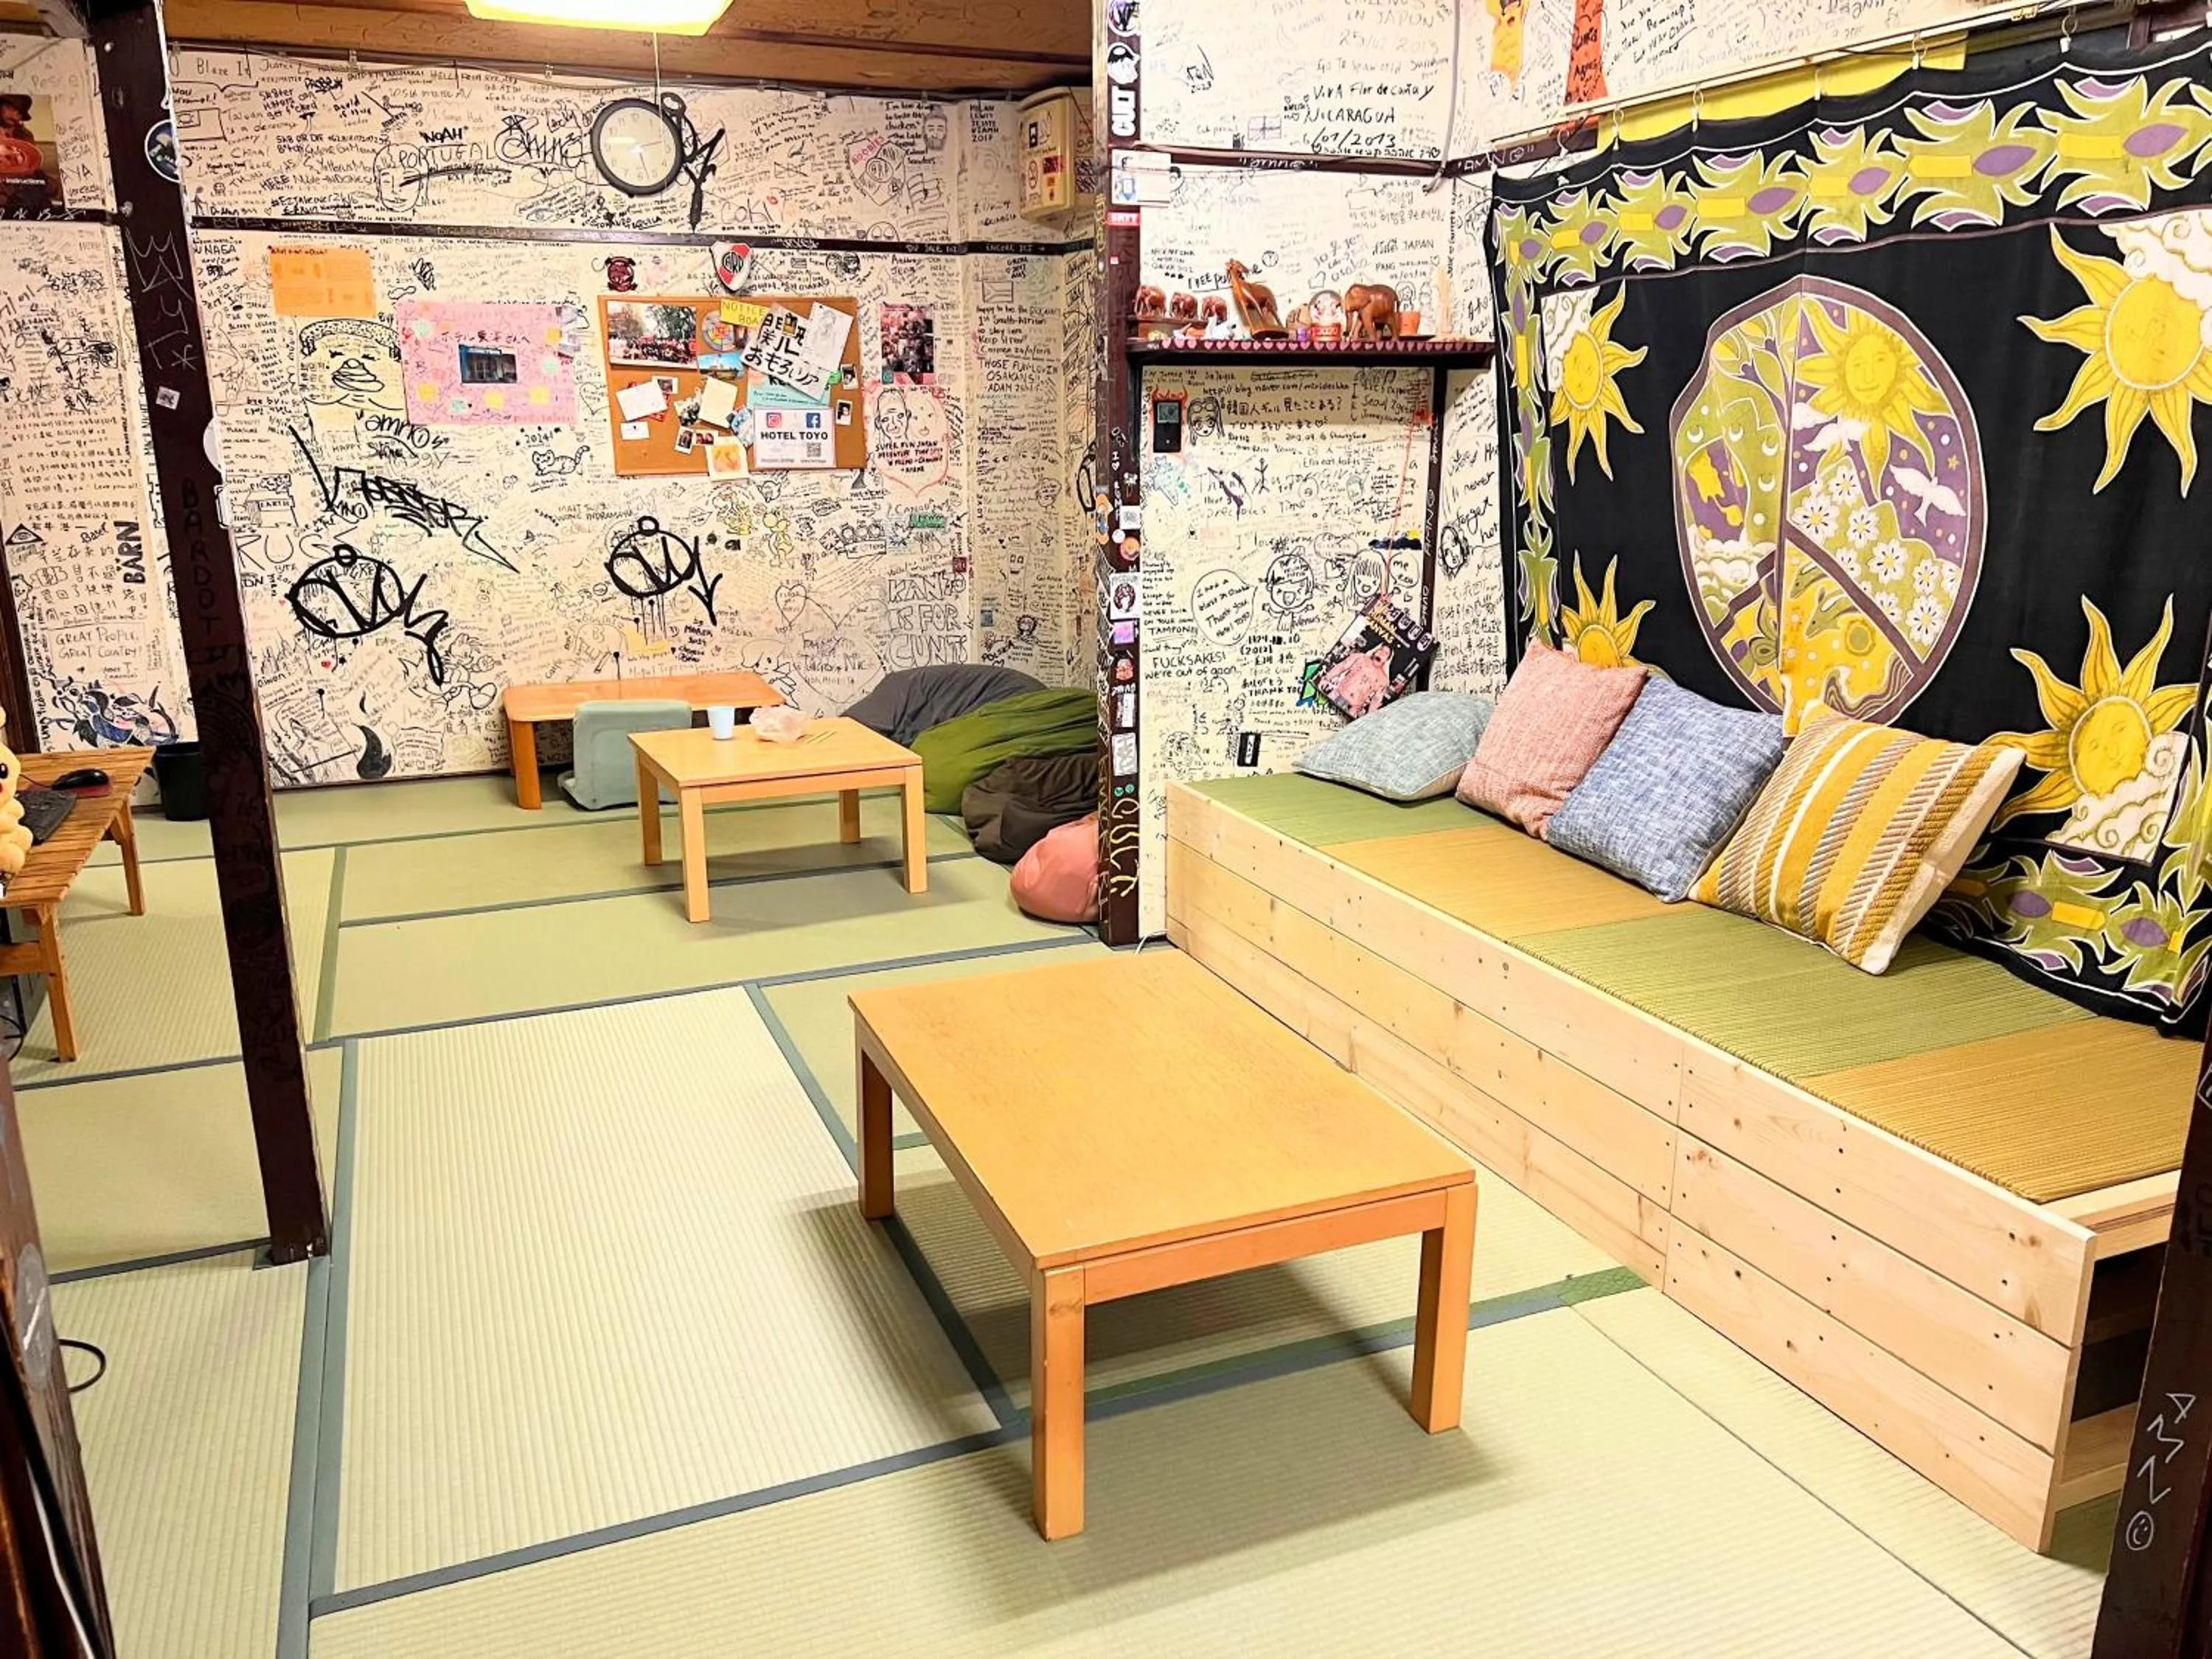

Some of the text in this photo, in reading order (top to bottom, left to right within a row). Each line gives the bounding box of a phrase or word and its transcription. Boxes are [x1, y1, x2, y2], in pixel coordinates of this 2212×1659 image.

[722, 301, 765, 316] NOTICE
[761, 432, 828, 440] HOTEL TOYO
